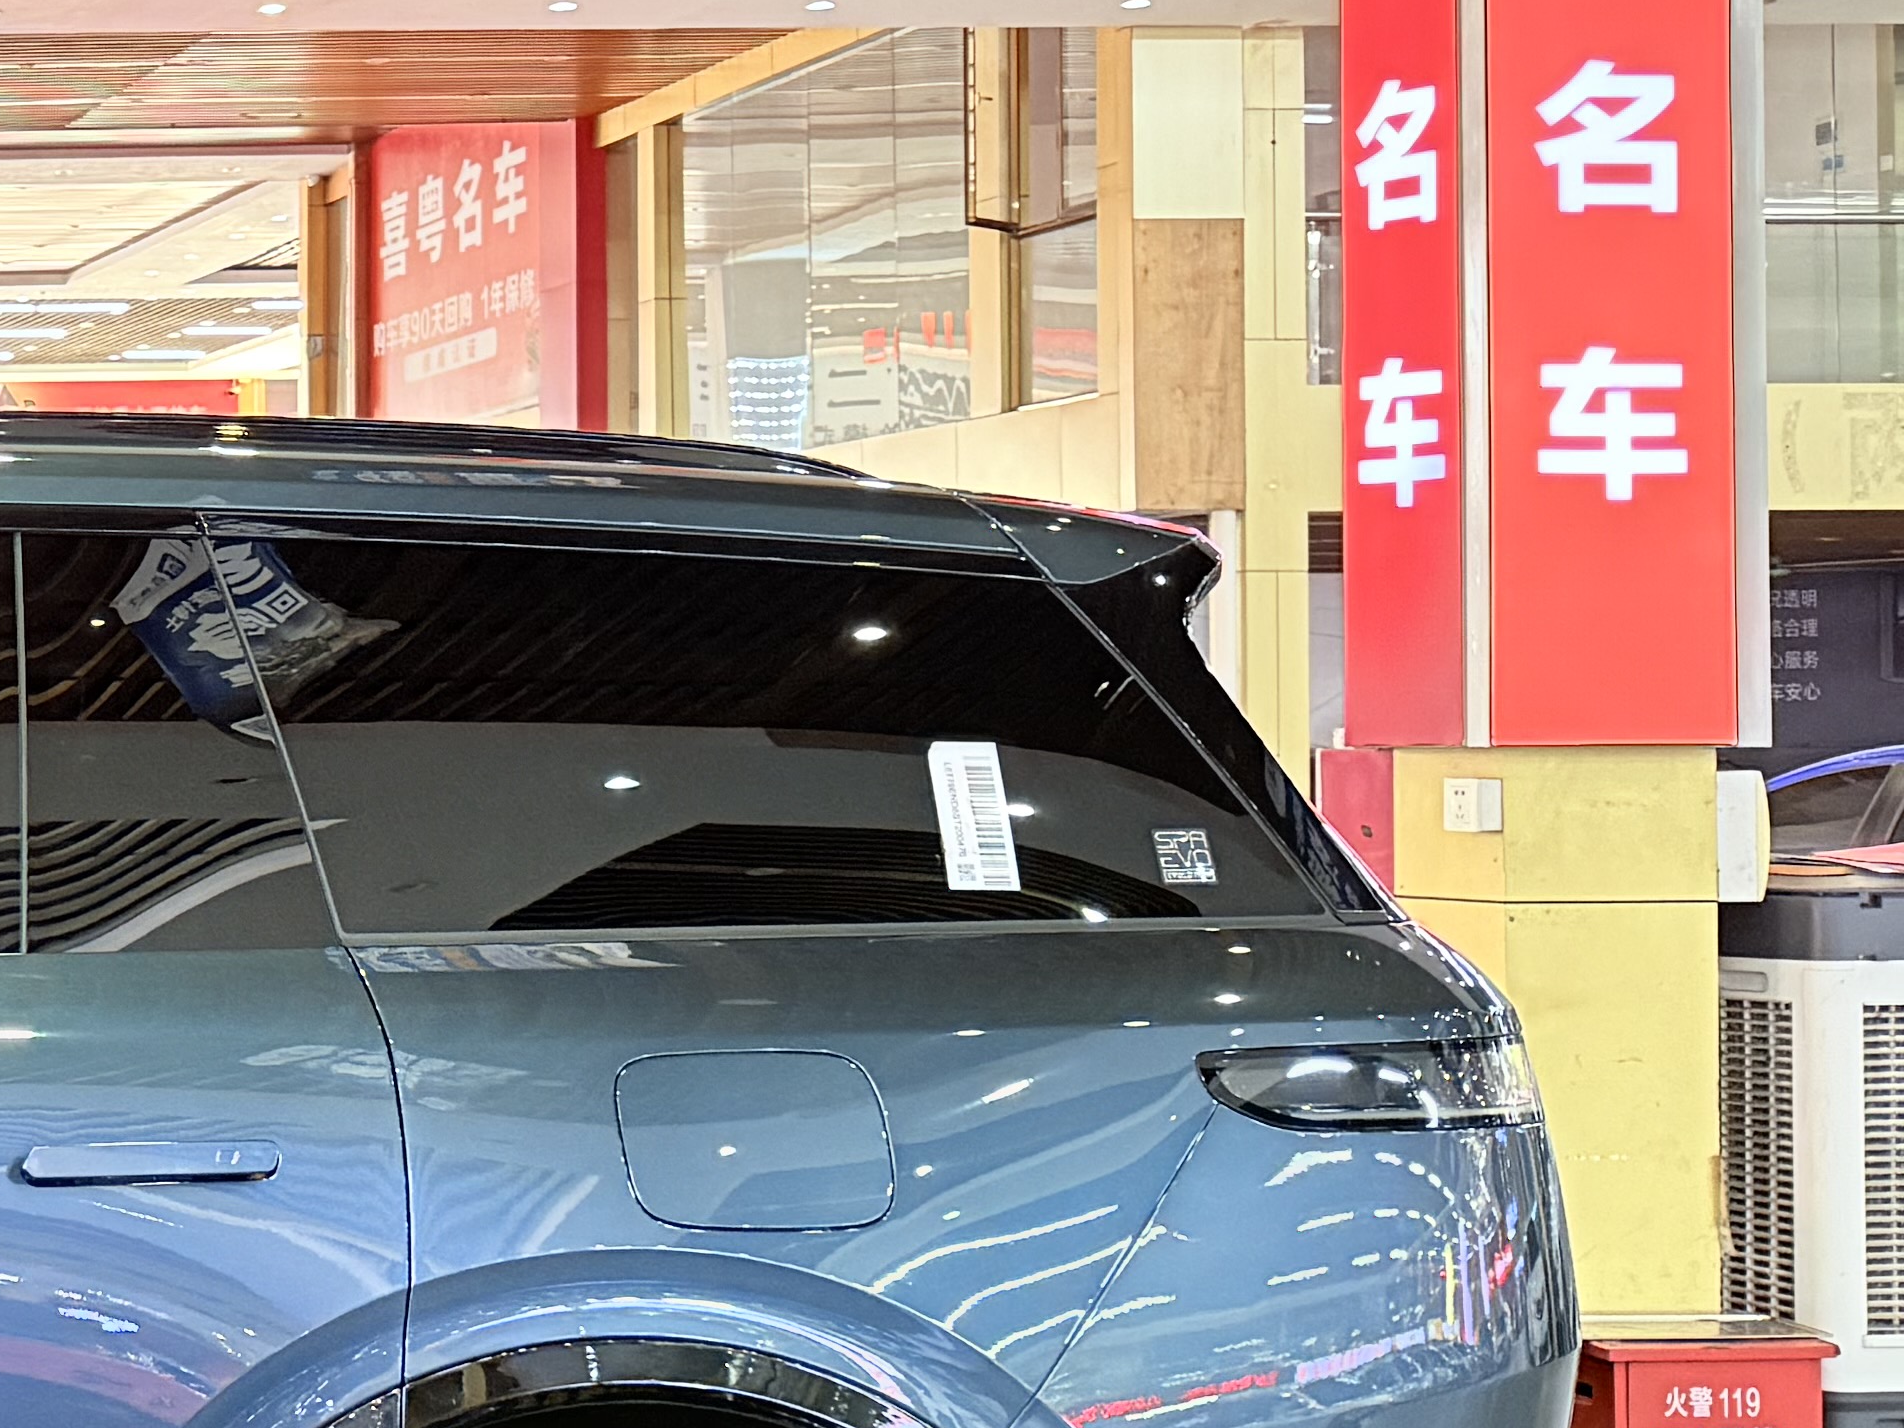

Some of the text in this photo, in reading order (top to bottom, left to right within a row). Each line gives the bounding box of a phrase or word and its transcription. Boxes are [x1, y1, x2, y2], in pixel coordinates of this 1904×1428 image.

[379, 139, 528, 284] 喜粤名车
[1154, 831, 1209, 849] SPA
[1157, 849, 1213, 868] EVO
[1664, 1386, 1761, 1418] 火警 119
